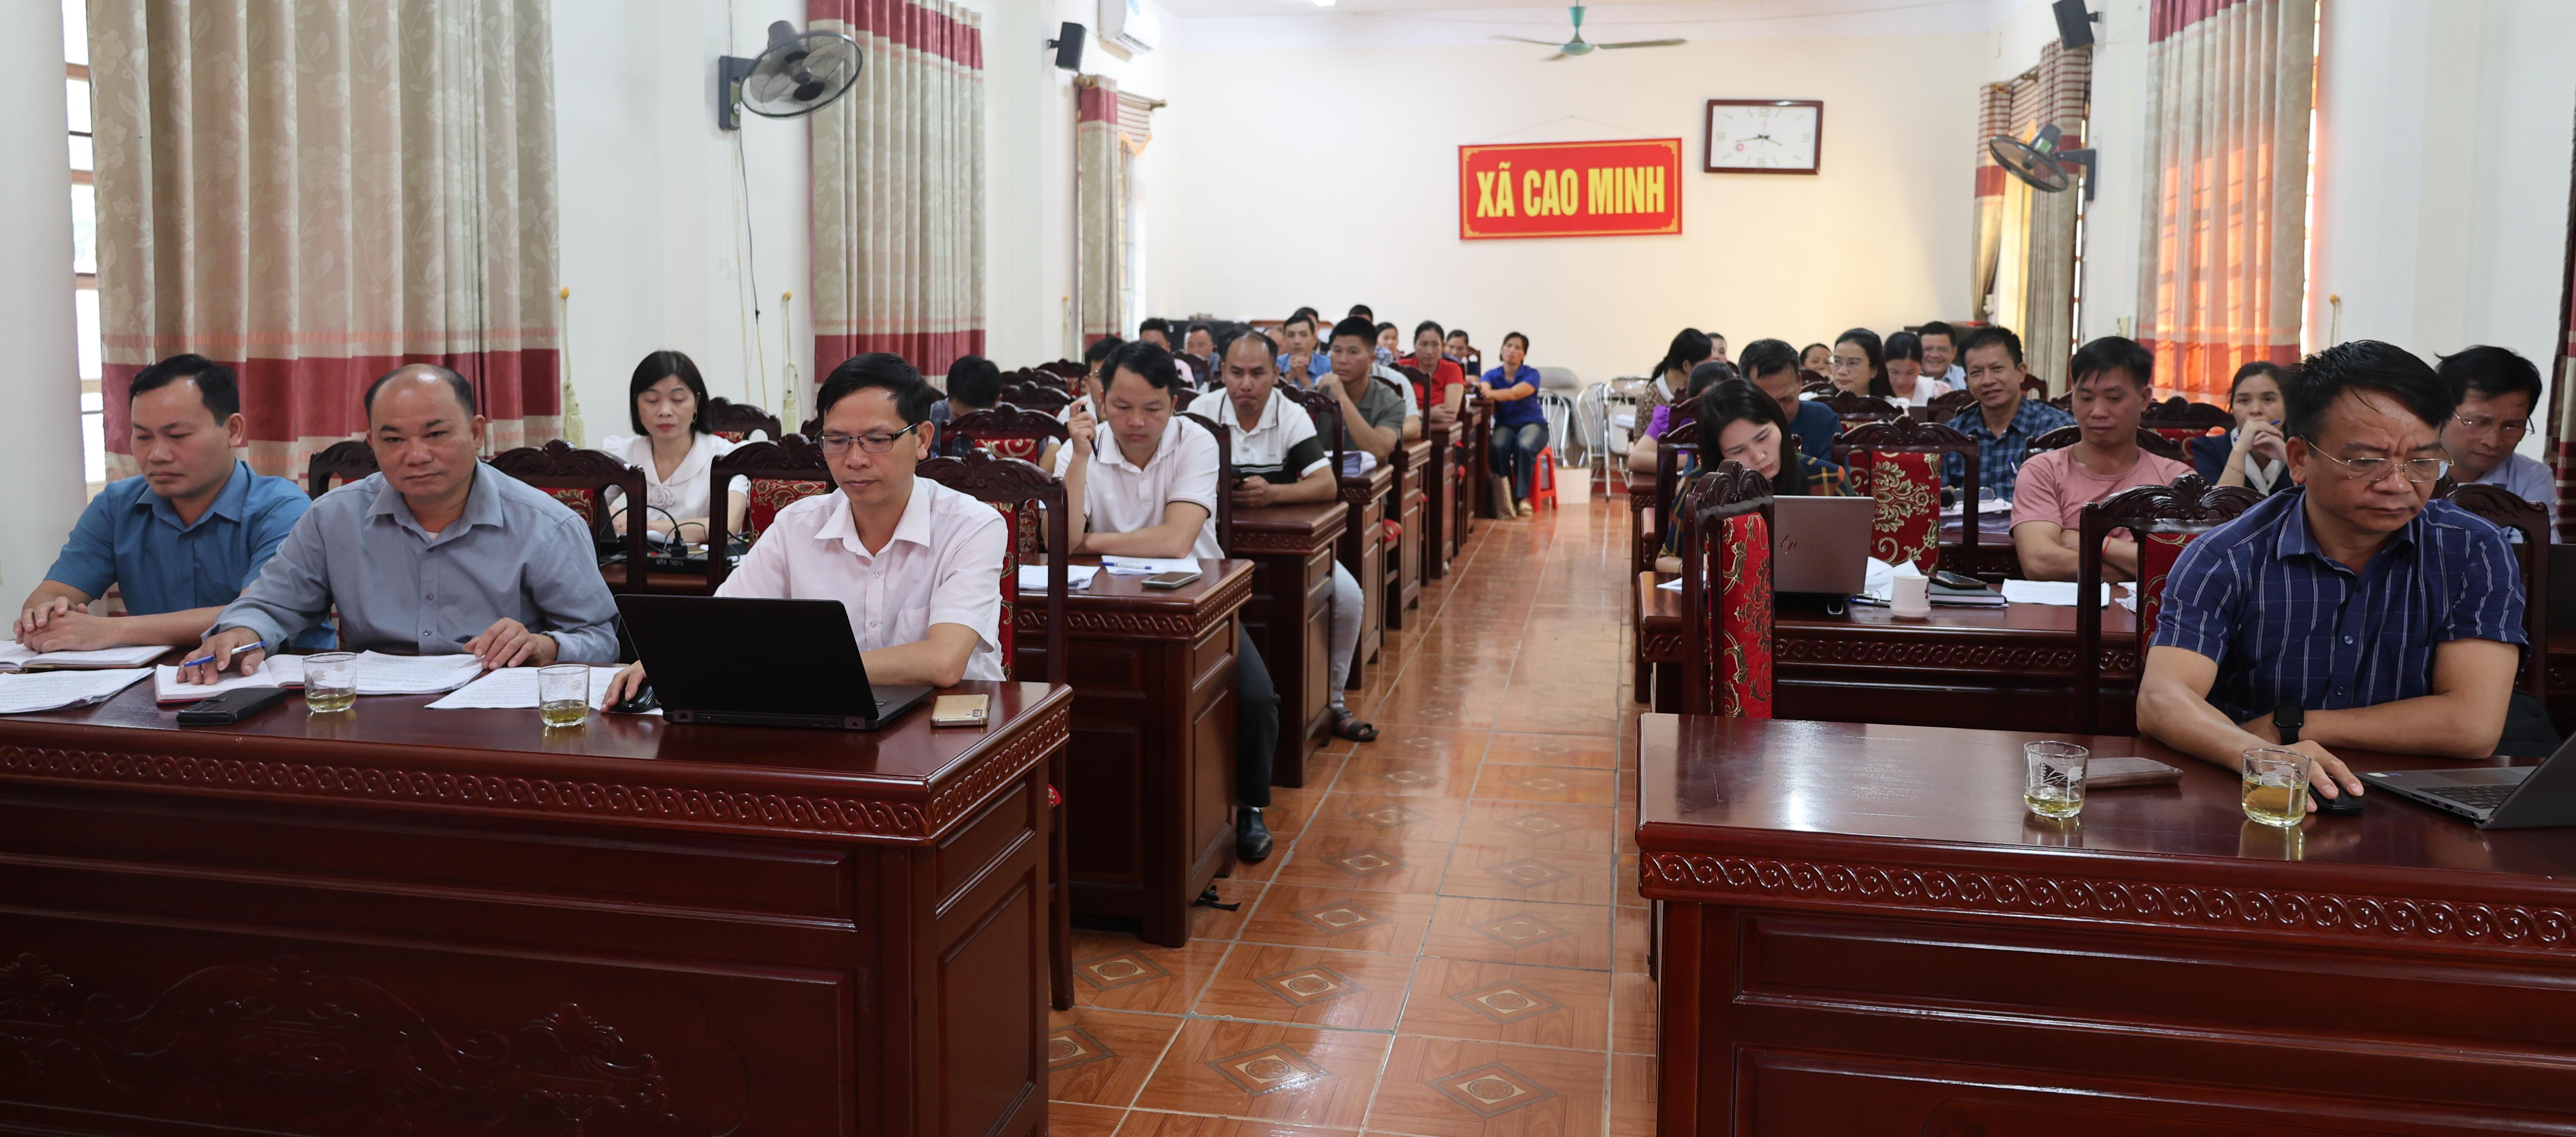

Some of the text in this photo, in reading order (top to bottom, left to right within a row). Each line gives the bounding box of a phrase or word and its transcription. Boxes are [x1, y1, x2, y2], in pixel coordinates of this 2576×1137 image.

[1476, 162, 1665, 217] XÃ CAO MINH
